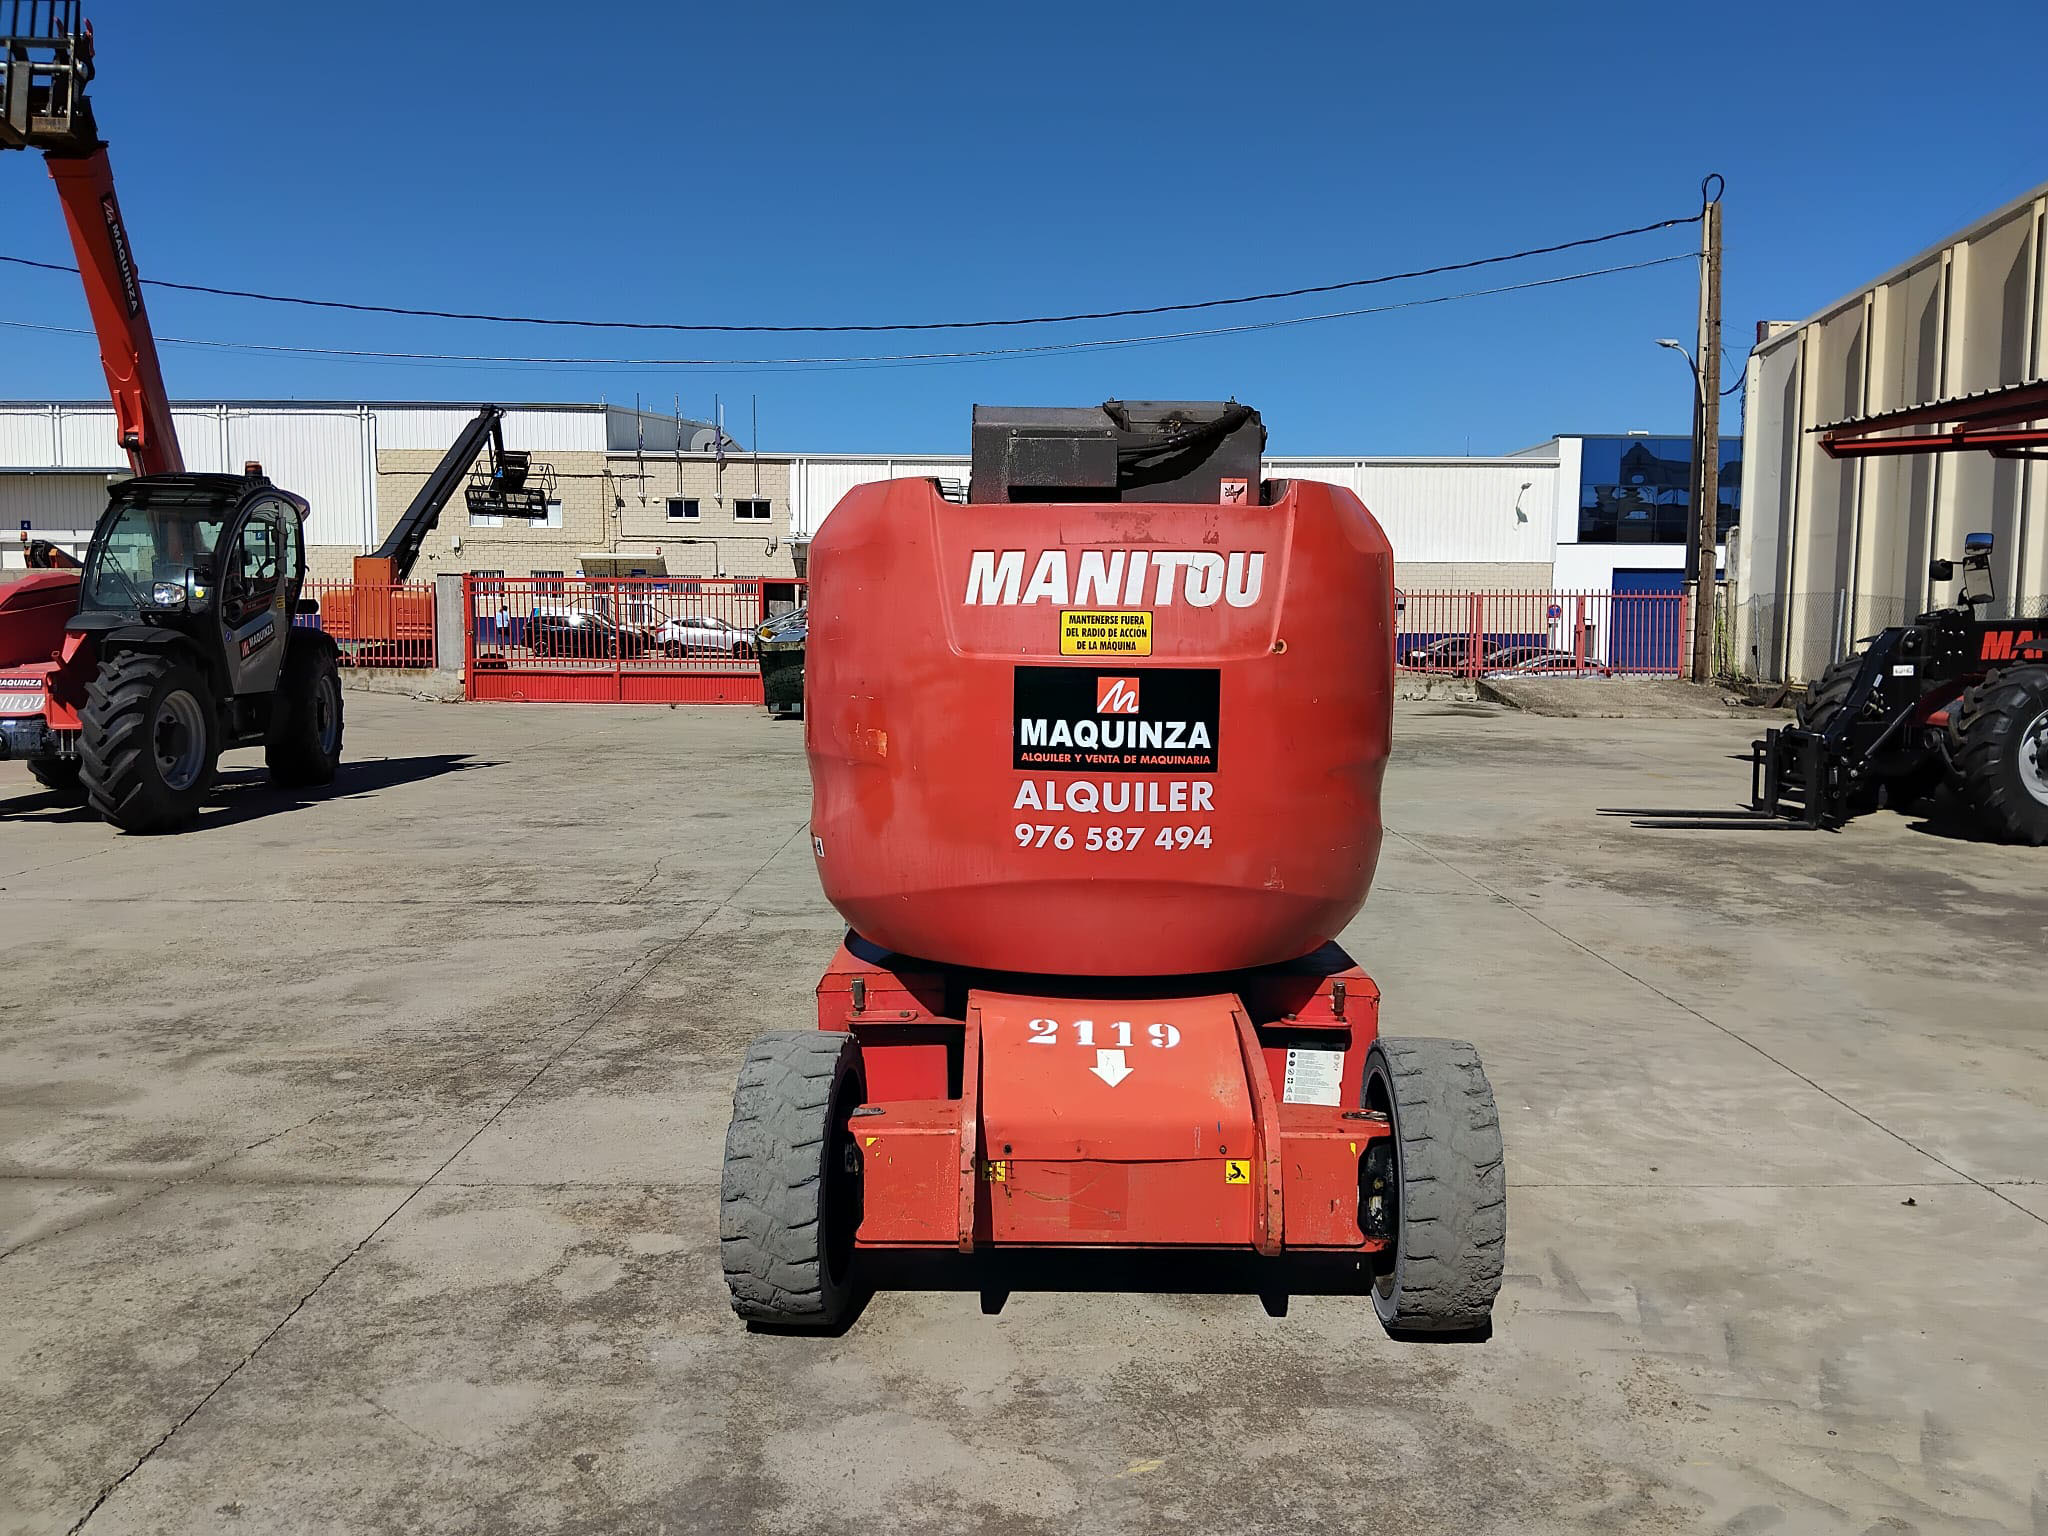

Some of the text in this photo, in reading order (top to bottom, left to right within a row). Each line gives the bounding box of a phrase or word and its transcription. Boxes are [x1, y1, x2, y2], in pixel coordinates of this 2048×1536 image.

[112, 223, 138, 312] MAQUINZA
[963, 549, 1266, 608] MANITOU
[1066, 626, 1147, 638] DEL RADIO DE ACCIÓN
[1069, 615, 1145, 625] MANTENERSE FUERA
[1077, 638, 1137, 651] DE LA MÁQUINA
[0, 679, 42, 687] AQUINZA
[1020, 718, 1212, 750] MAQUINZA
[1021, 752, 1211, 765] ALQUILER Y VENTA DE MAQUINARIA
[1013, 780, 1215, 814] ALQUILER
[1014, 823, 1213, 851] 976 587 494
[1027, 1018, 1181, 1048] 2119
